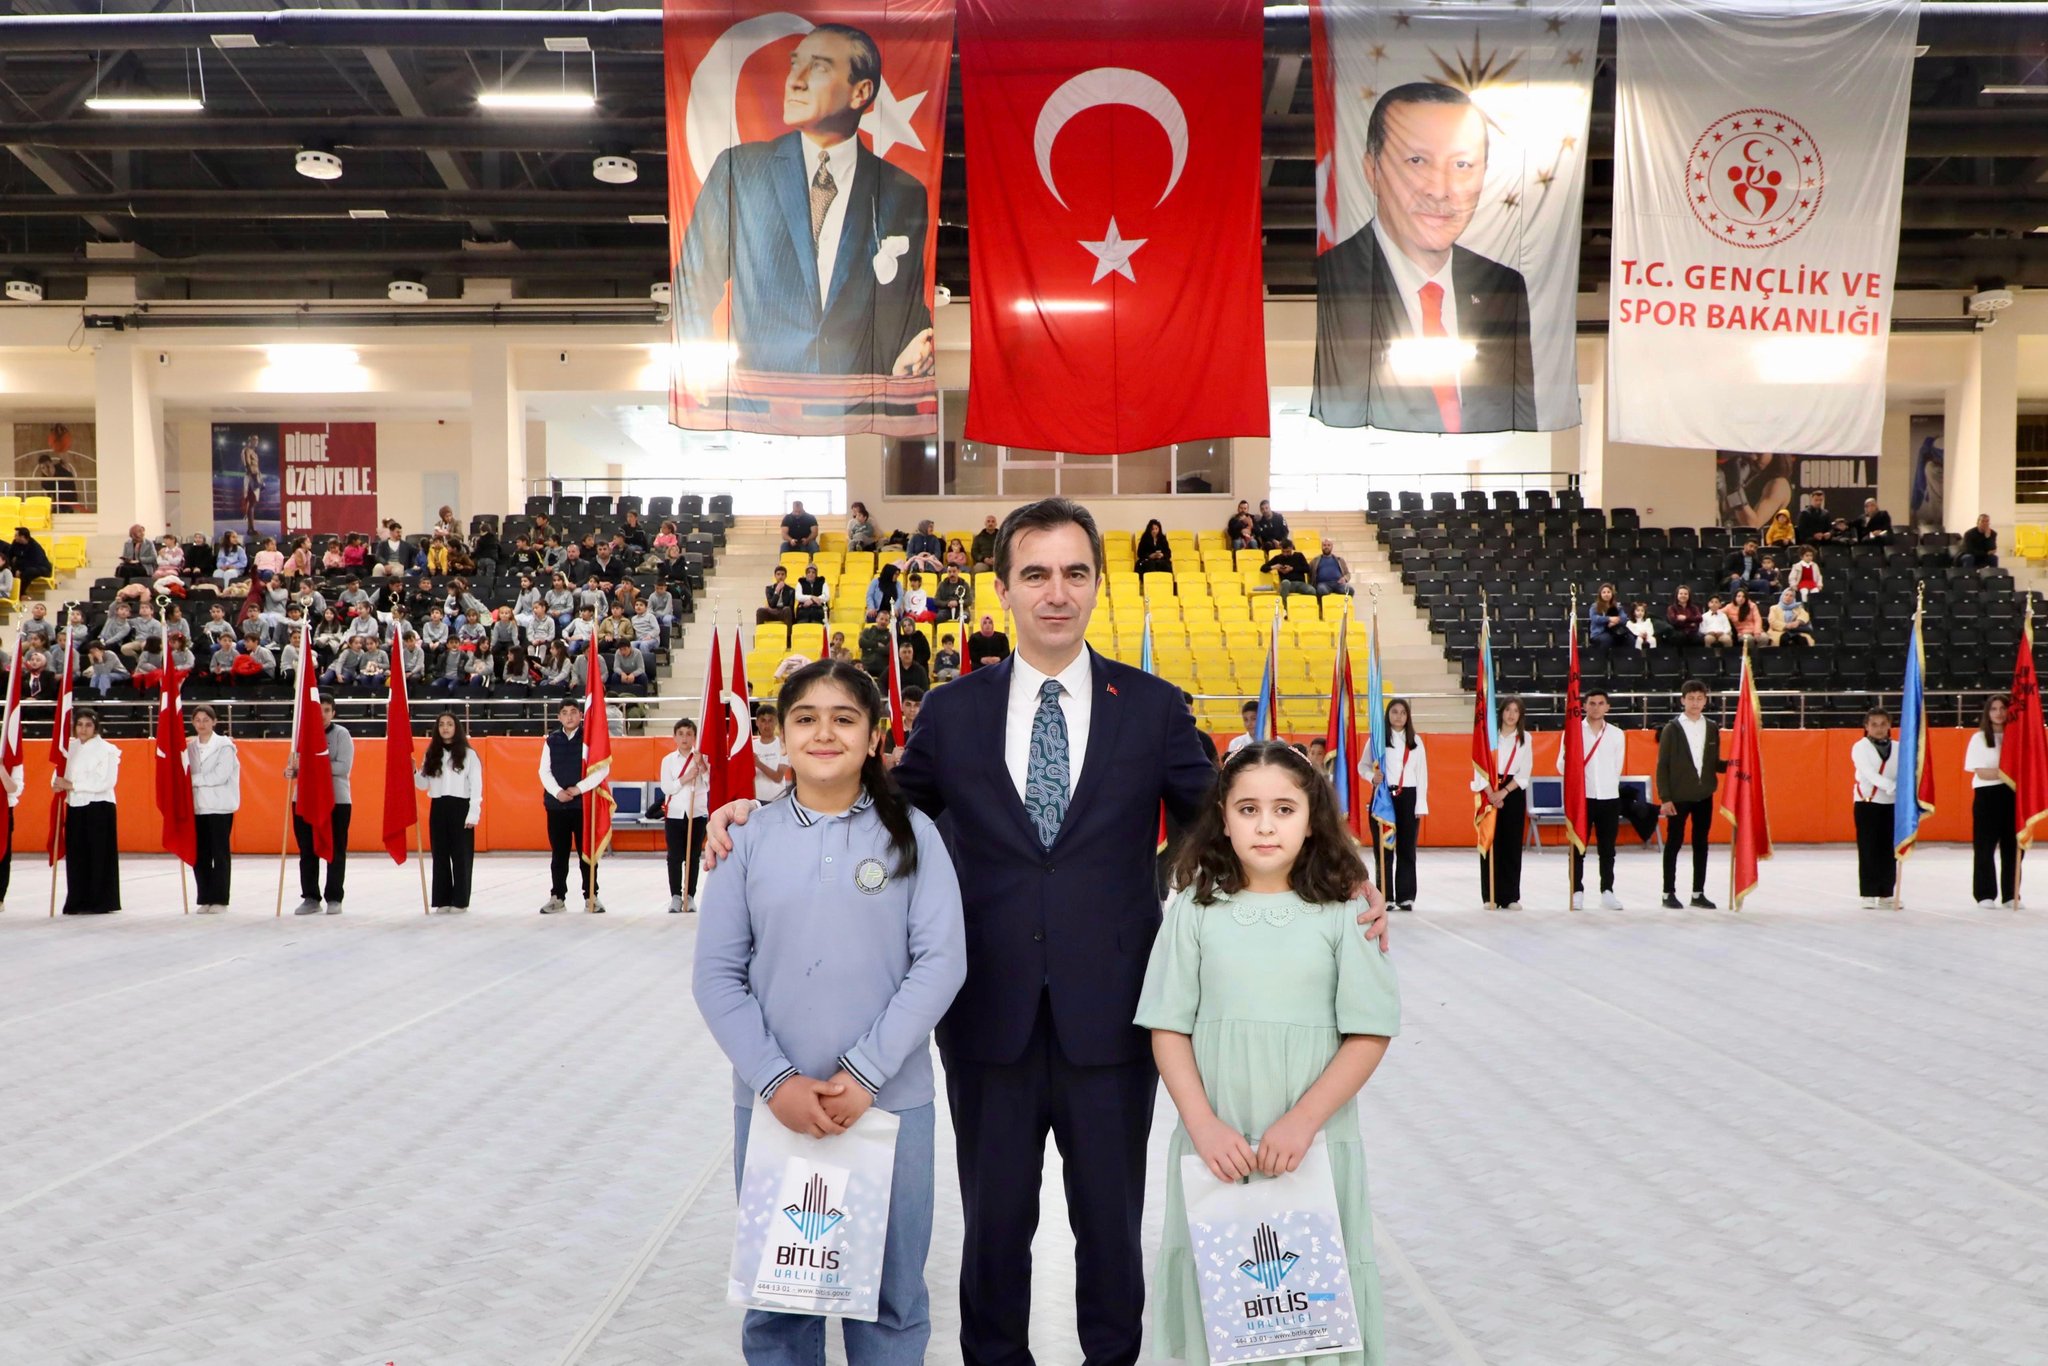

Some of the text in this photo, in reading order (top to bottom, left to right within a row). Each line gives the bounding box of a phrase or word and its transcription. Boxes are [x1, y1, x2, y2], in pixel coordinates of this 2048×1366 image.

[1621, 260, 1881, 300] T.C. GENÇLİK VE
[1620, 299, 1879, 336] SPOR BAKANLIĞI
